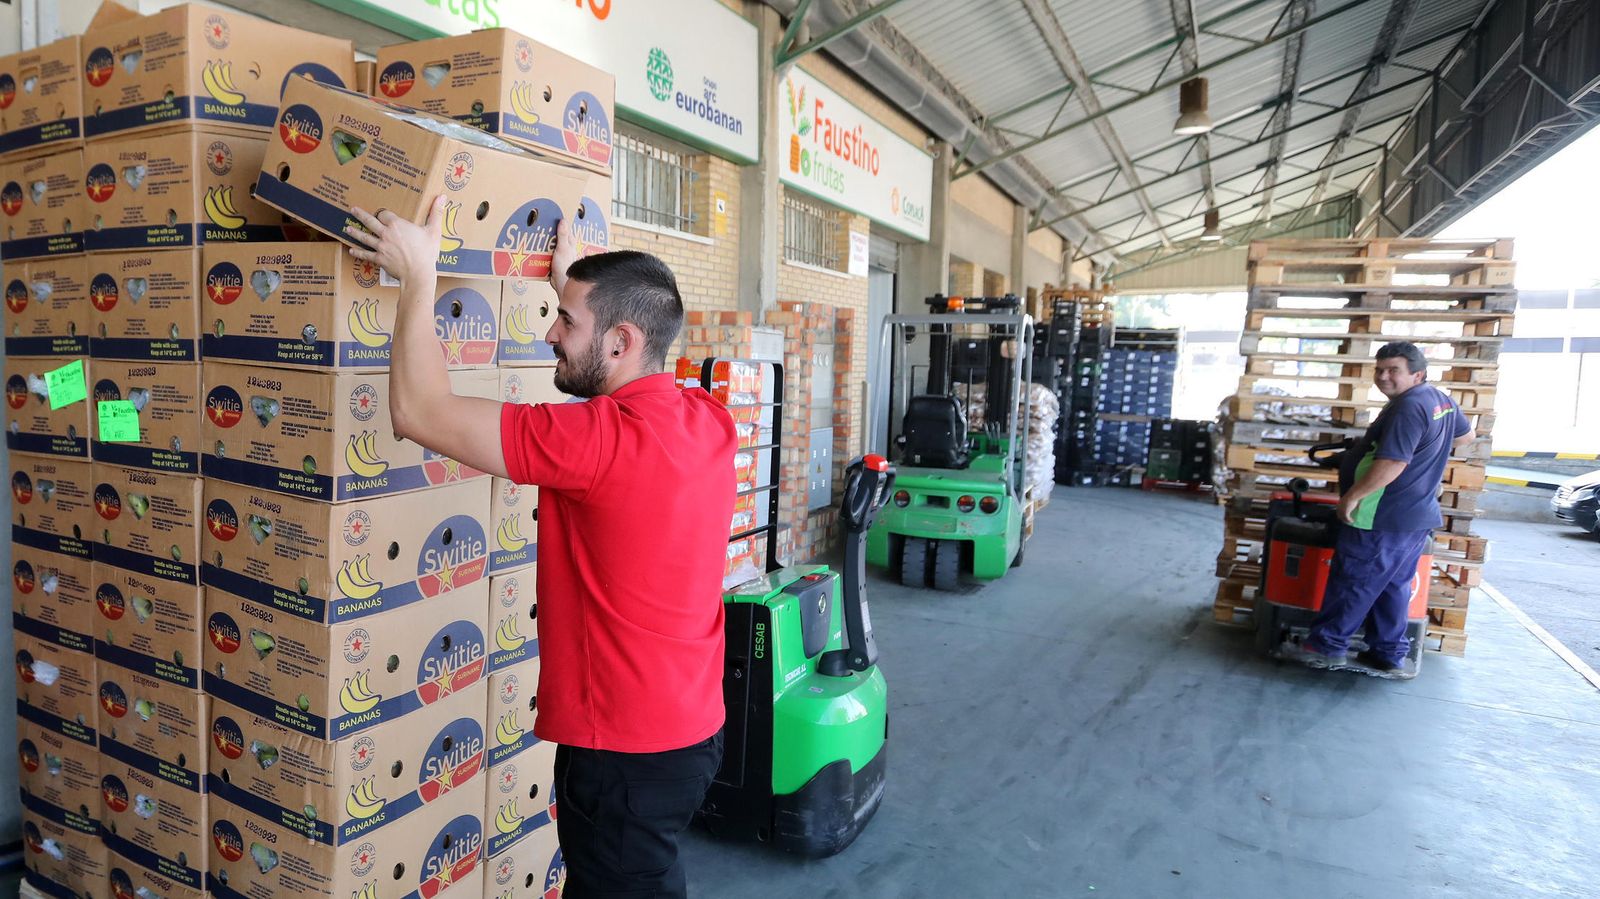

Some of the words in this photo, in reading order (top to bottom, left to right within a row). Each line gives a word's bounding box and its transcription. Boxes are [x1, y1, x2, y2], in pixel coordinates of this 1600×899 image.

[383, 68, 413, 82] Switie
[704, 88, 716, 103] arc
[204, 104, 246, 118] BANANAS
[676, 91, 742, 136] eurobanan
[284, 112, 320, 138] Switie
[508, 120, 540, 137] BANANAS
[568, 108, 609, 142] Switie
[814, 97, 880, 176] Faustino
[813, 150, 845, 194] frutas
[206, 230, 248, 240] BANANAS
[502, 223, 556, 252] Switie
[573, 220, 605, 244] witie
[209, 274, 240, 288] Switie
[434, 314, 492, 341] Switie
[348, 350, 390, 360] BANANAS
[506, 346, 536, 354] BANANAS
[354, 385, 370, 398] MADE
[208, 396, 240, 411] Switie
[346, 477, 388, 492] BANANAS
[208, 508, 236, 526] Switie
[424, 538, 482, 574] Switie
[495, 551, 527, 564] BANANAS
[458, 564, 482, 578] SURINAME
[337, 597, 382, 615] BANANAS
[210, 620, 239, 640] Switie
[755, 622, 765, 658] CESAB
[424, 641, 480, 680] Switie
[494, 649, 525, 665] BANANAS
[456, 664, 481, 681] SURINAME
[339, 709, 381, 731] BANANAS
[215, 723, 242, 745] Switie
[426, 736, 480, 780] Switie
[494, 741, 523, 759] BANANAS
[245, 820, 277, 843] 1223923
[345, 812, 386, 836] BANANAS
[215, 826, 241, 848] Switie
[494, 828, 522, 848] BANANAS
[426, 832, 479, 879] Switie
